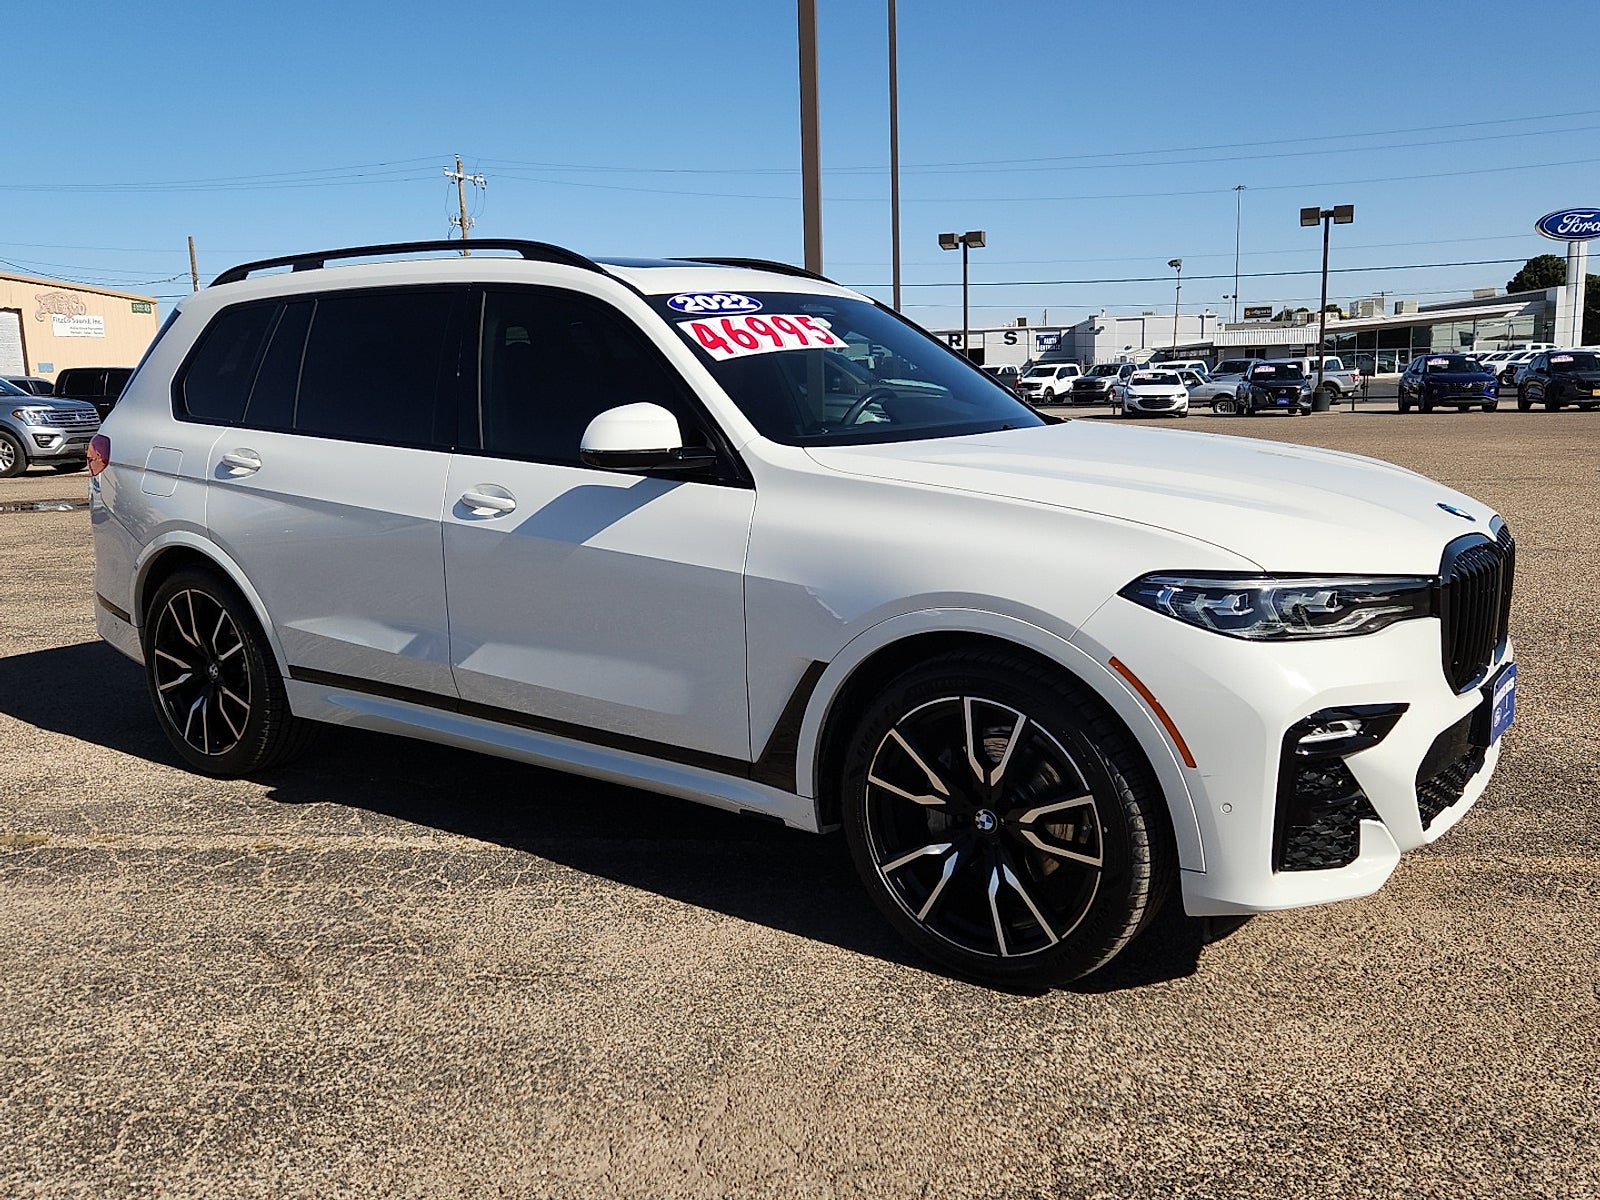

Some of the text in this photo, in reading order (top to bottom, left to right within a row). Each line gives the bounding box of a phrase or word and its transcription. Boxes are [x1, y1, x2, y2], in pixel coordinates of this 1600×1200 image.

[675, 295, 757, 311] 2022
[691, 315, 835, 355] 46995
[949, 331, 1018, 346] R S
